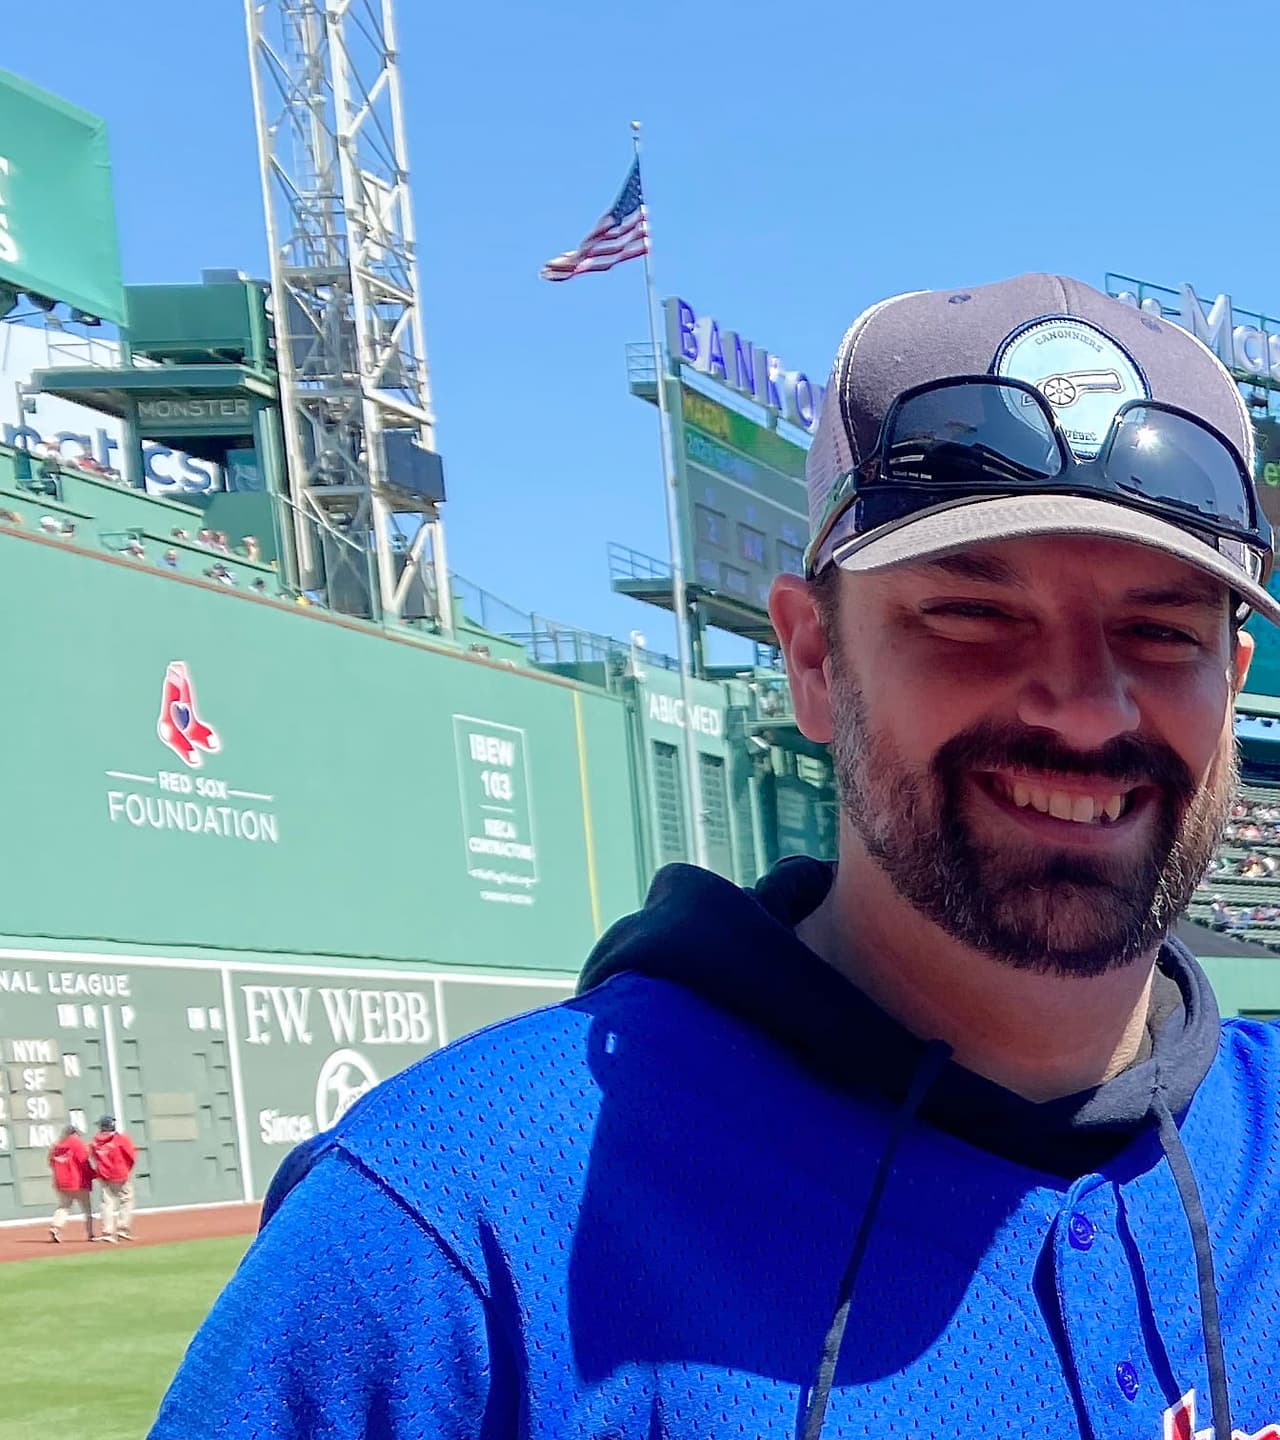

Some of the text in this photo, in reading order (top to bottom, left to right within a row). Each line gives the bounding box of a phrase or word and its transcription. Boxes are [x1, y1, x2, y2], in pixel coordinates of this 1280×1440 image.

[1034, 329, 1104, 353] CANONNIERS
[137, 399, 249, 420] MONSTER
[158, 771, 228, 799] RED SOX
[480, 770, 513, 800] 103
[108, 791, 279, 842] FOUNDATION
[48, 972, 131, 996] LEAGUE
[240, 985, 432, 1045] F.W. WEBB
[13, 1040, 51, 1062] NYM
[64, 1054, 80, 1077] N
[23, 1068, 47, 1092] SF
[27, 1096, 50, 1119] SD
[259, 1108, 314, 1146] Since
